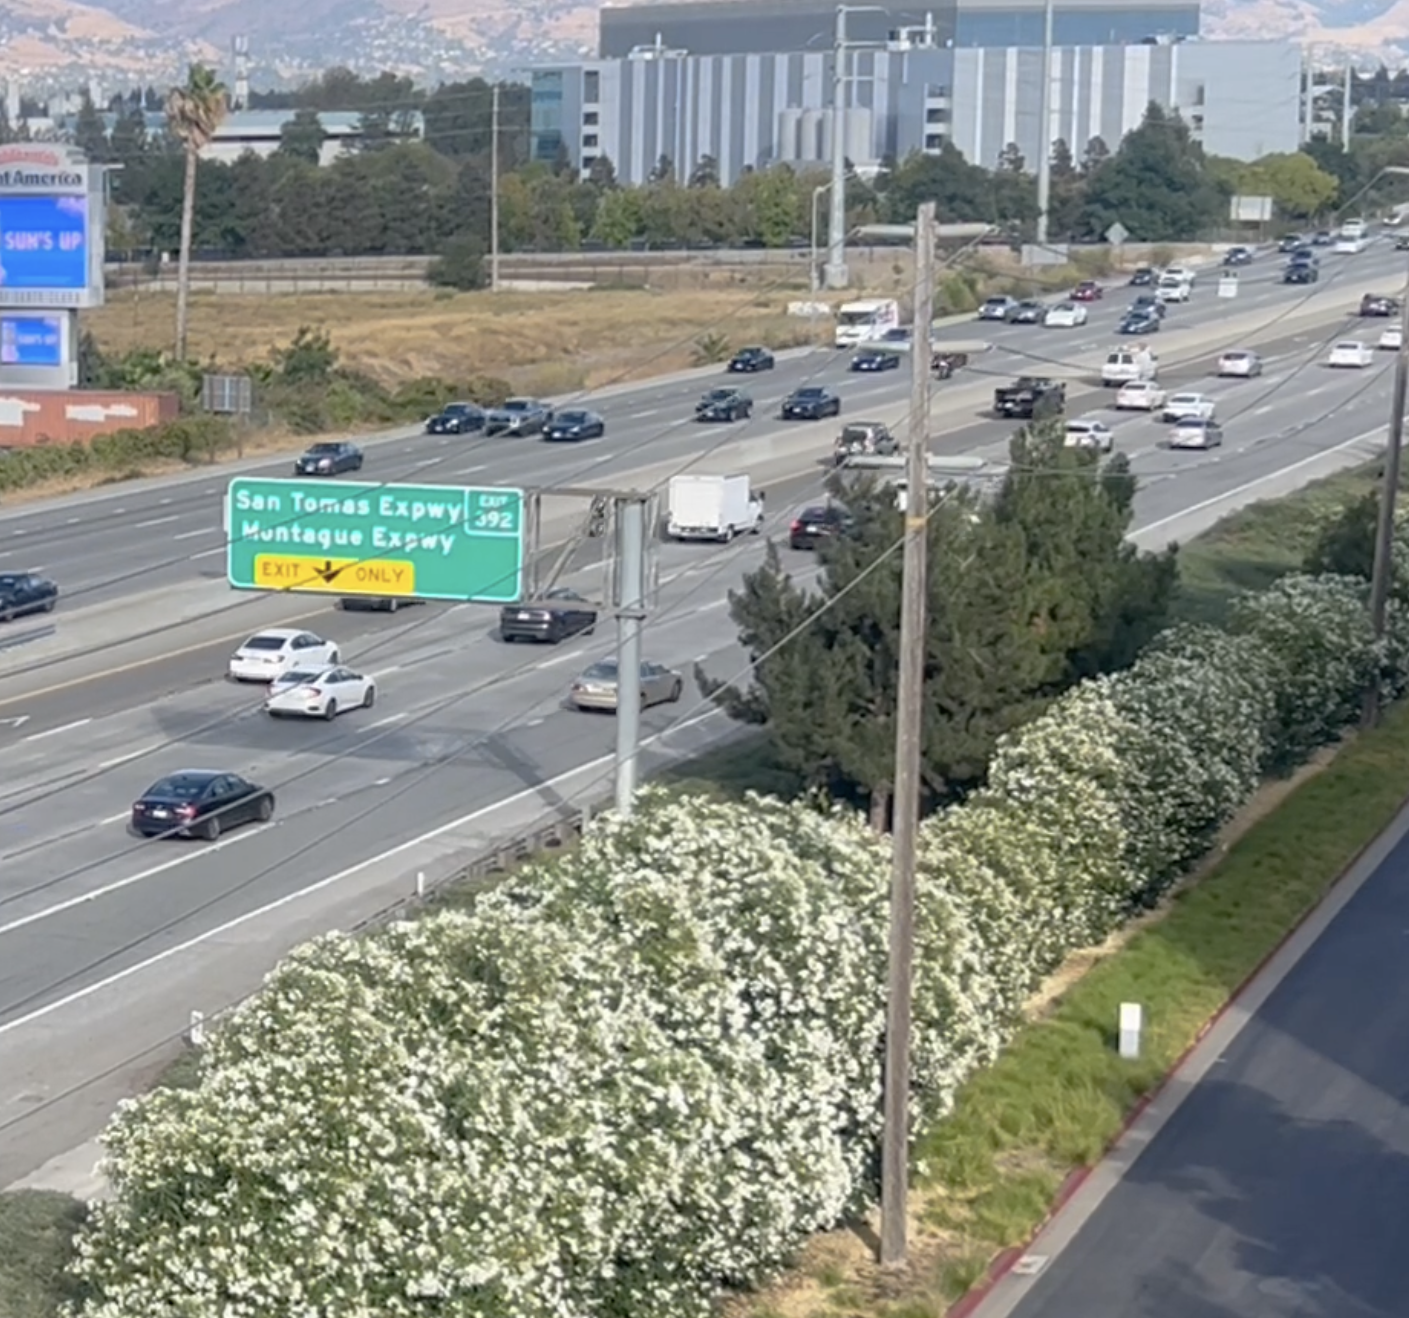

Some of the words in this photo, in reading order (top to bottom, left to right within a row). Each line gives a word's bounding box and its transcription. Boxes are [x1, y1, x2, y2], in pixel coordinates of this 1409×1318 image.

[11, 170, 82, 186] America
[4, 231, 53, 250] SUN'S
[59, 231, 82, 250] UP
[236, 489, 281, 511] San
[291, 492, 370, 515] Tomas
[379, 496, 463, 524] Expwy
[479, 494, 507, 507] EXIT
[475, 510, 513, 528] 392
[242, 521, 363, 549] Montague
[372, 526, 455, 555] Expwy
[262, 561, 301, 579] EXIT
[355, 567, 405, 584] ONLY
